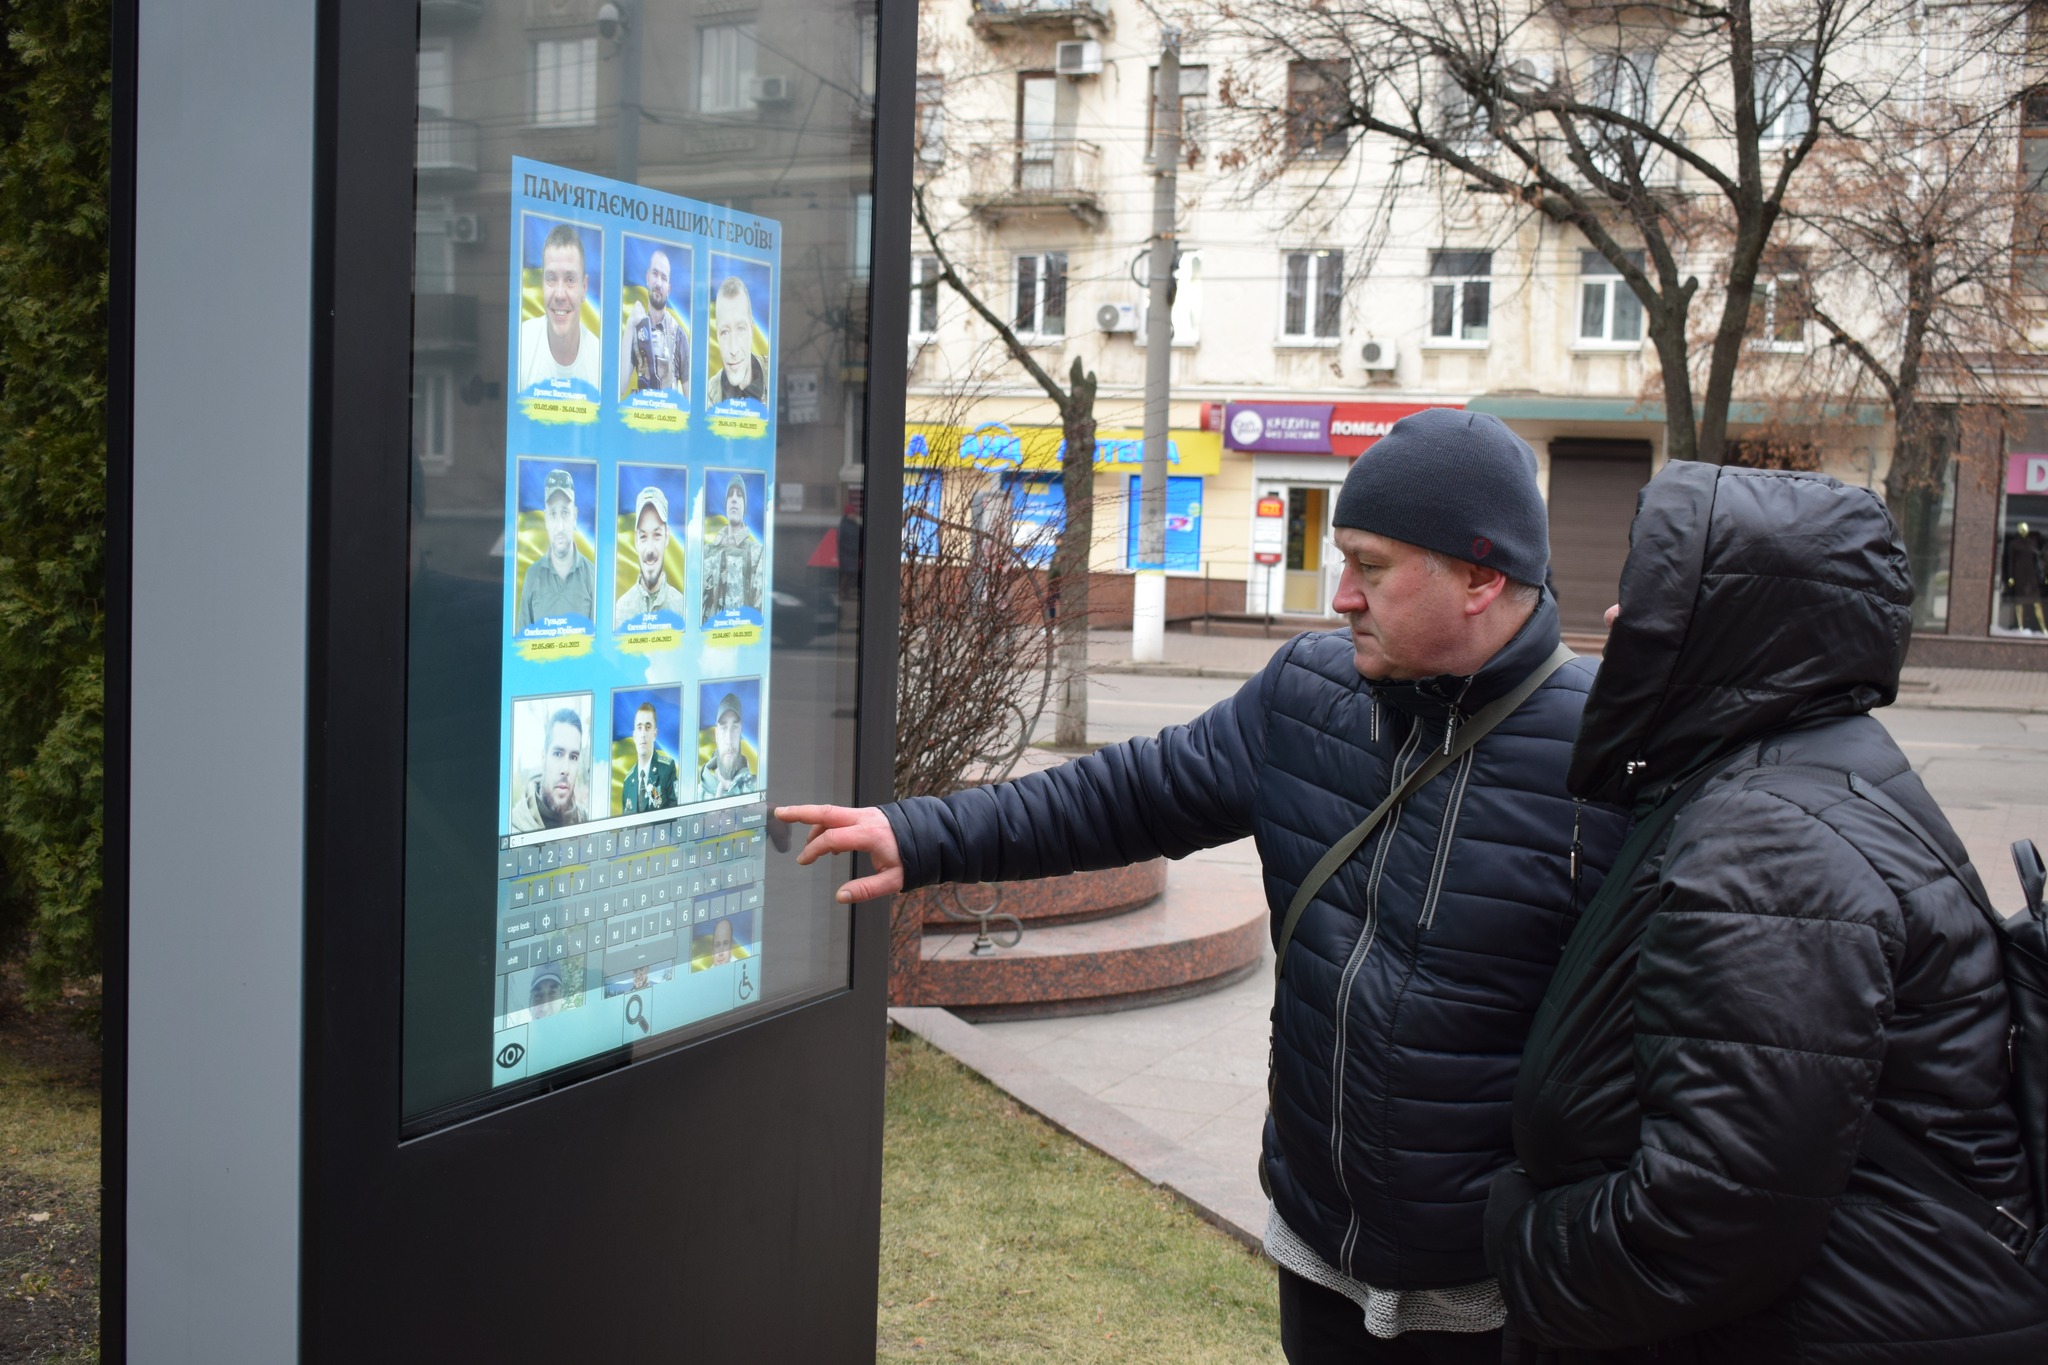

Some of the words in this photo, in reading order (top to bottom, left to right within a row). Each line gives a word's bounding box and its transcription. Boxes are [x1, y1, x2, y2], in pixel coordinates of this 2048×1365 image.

[523, 174, 649, 221] ПАМ'ЯТАЄМО
[652, 204, 715, 237] НАШИХ
[717, 220, 772, 250] ГЕРОЇВ!
[1331, 420, 1397, 437] ЛОМБАР
